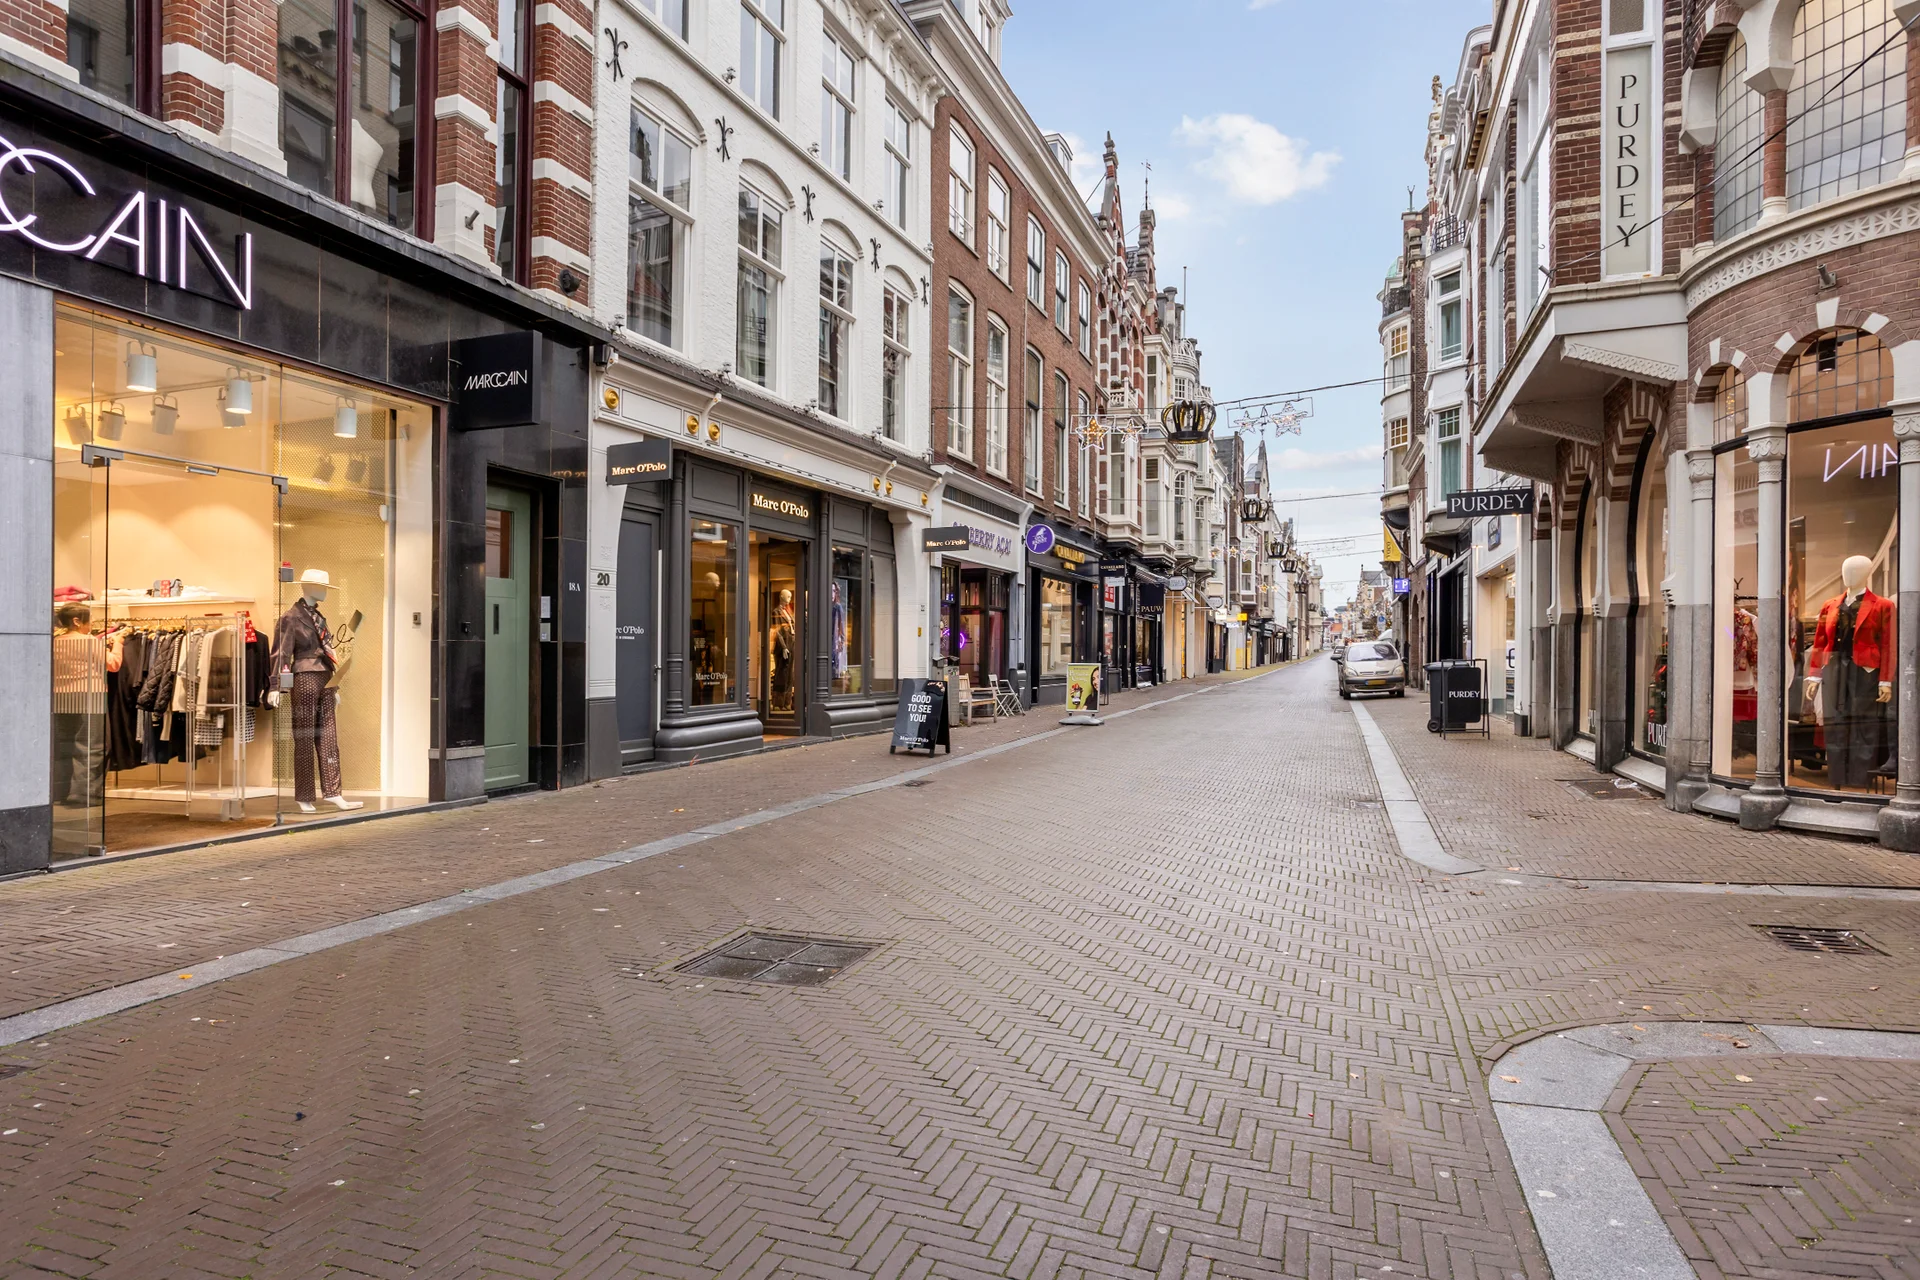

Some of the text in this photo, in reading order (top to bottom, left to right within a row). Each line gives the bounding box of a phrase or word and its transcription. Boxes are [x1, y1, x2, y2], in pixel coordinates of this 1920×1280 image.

[1616, 74, 1640, 247] PURDEY
[612, 462, 667, 476] Marc O'Polo
[753, 493, 809, 518] Marc O'Polo
[1451, 493, 1528, 513] PURDEY
[597, 572, 610, 586] 20
[1402, 580, 1409, 589] P
[911, 694, 932, 704] GOOD
[1448, 690, 1480, 699] PURDEY
[907, 703, 932, 713] TO SEE
[909, 713, 927, 723] YOU!
